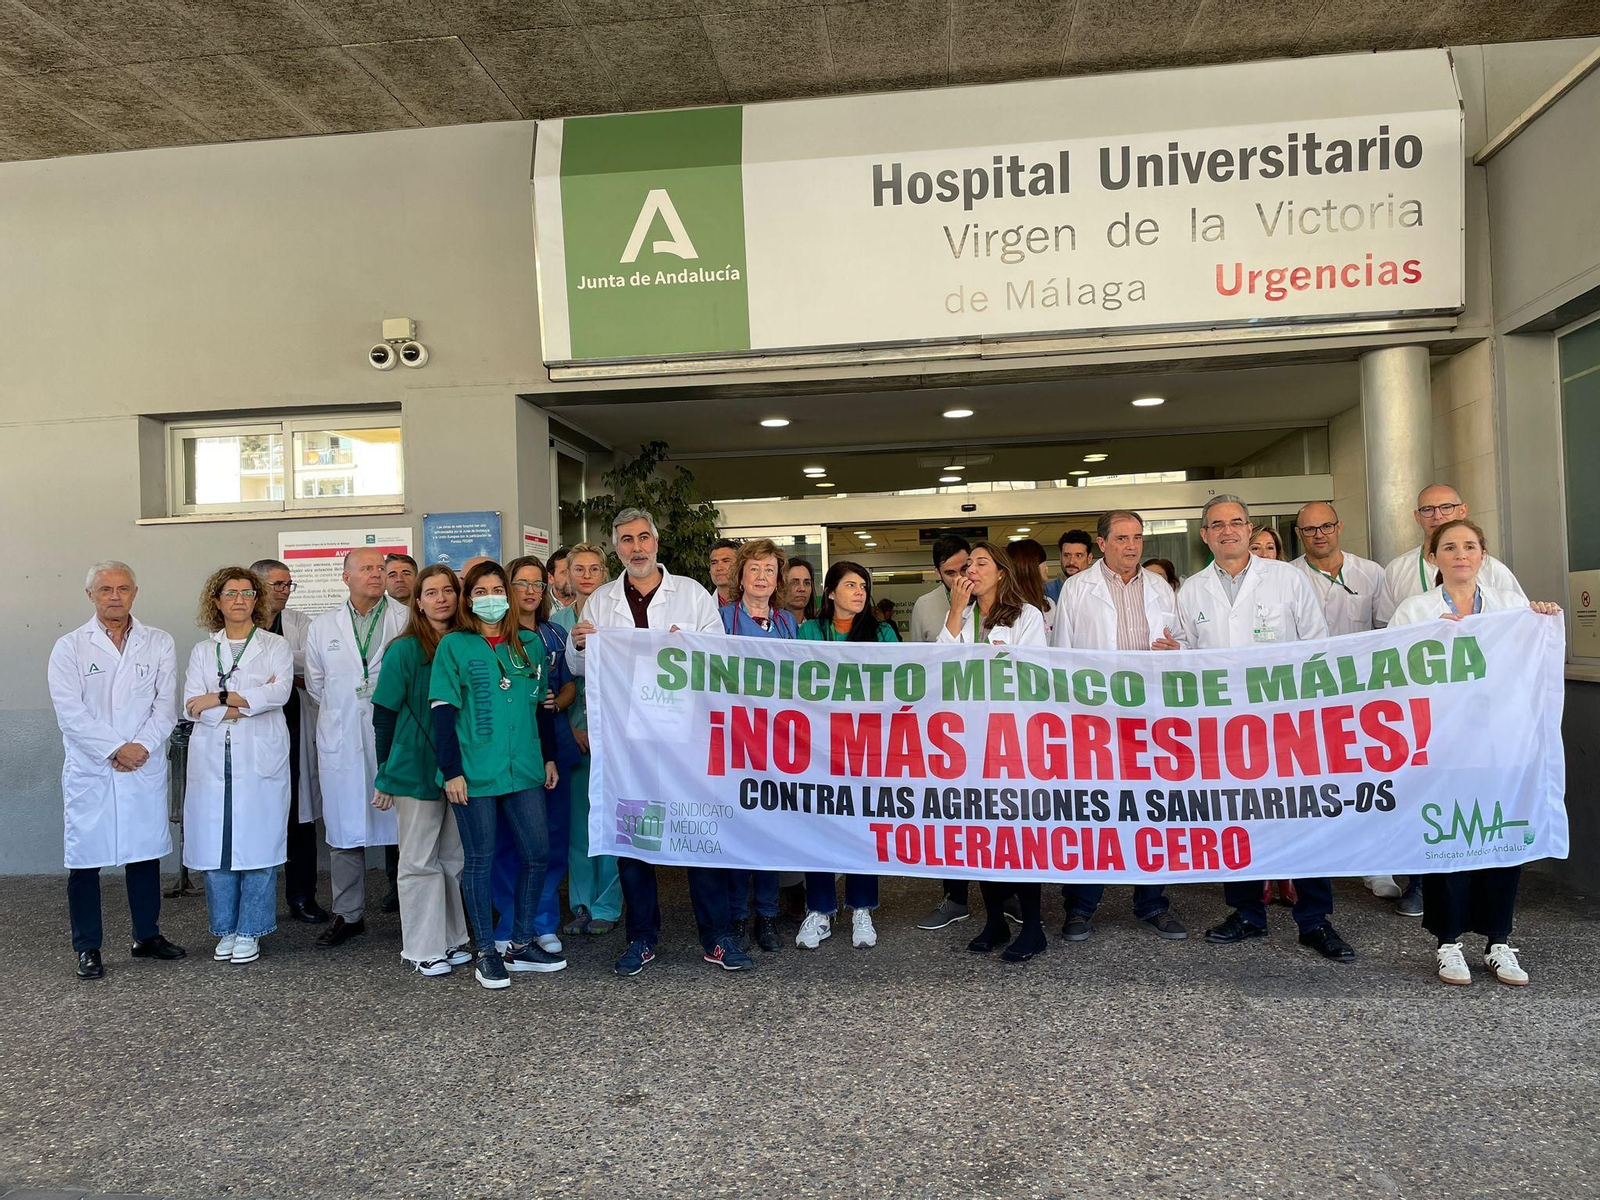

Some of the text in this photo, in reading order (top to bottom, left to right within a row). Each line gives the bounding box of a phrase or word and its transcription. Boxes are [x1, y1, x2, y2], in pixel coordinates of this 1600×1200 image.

[872, 125, 1423, 211] Hospital Universitario
[942, 192, 1424, 264] Virgen de la Victoria
[576, 264, 741, 290] Junta de Andalucía
[944, 277, 1146, 314] de Málaga
[1215, 253, 1423, 302] Urgencias
[656, 636, 1487, 708] SINDICATO MÉDICO DE MÁLAGA
[468, 659, 495, 736] QUIRÓFANO
[707, 697, 1432, 782] ¡NO MÁS AGRESIONES!
[669, 801, 734, 819] SINDICATO
[739, 778, 1397, 822] CONTRA LAS AGRESIONES A SANITARIAS-OS
[1421, 797, 1529, 849] SMA
[669, 836, 723, 854] MÁLAGA
[670, 818, 718, 836] MÉDICO
[869, 823, 1252, 872] TOLERANCIA CERO
[1425, 844, 1527, 860] Sindicato Médico Andaluz
